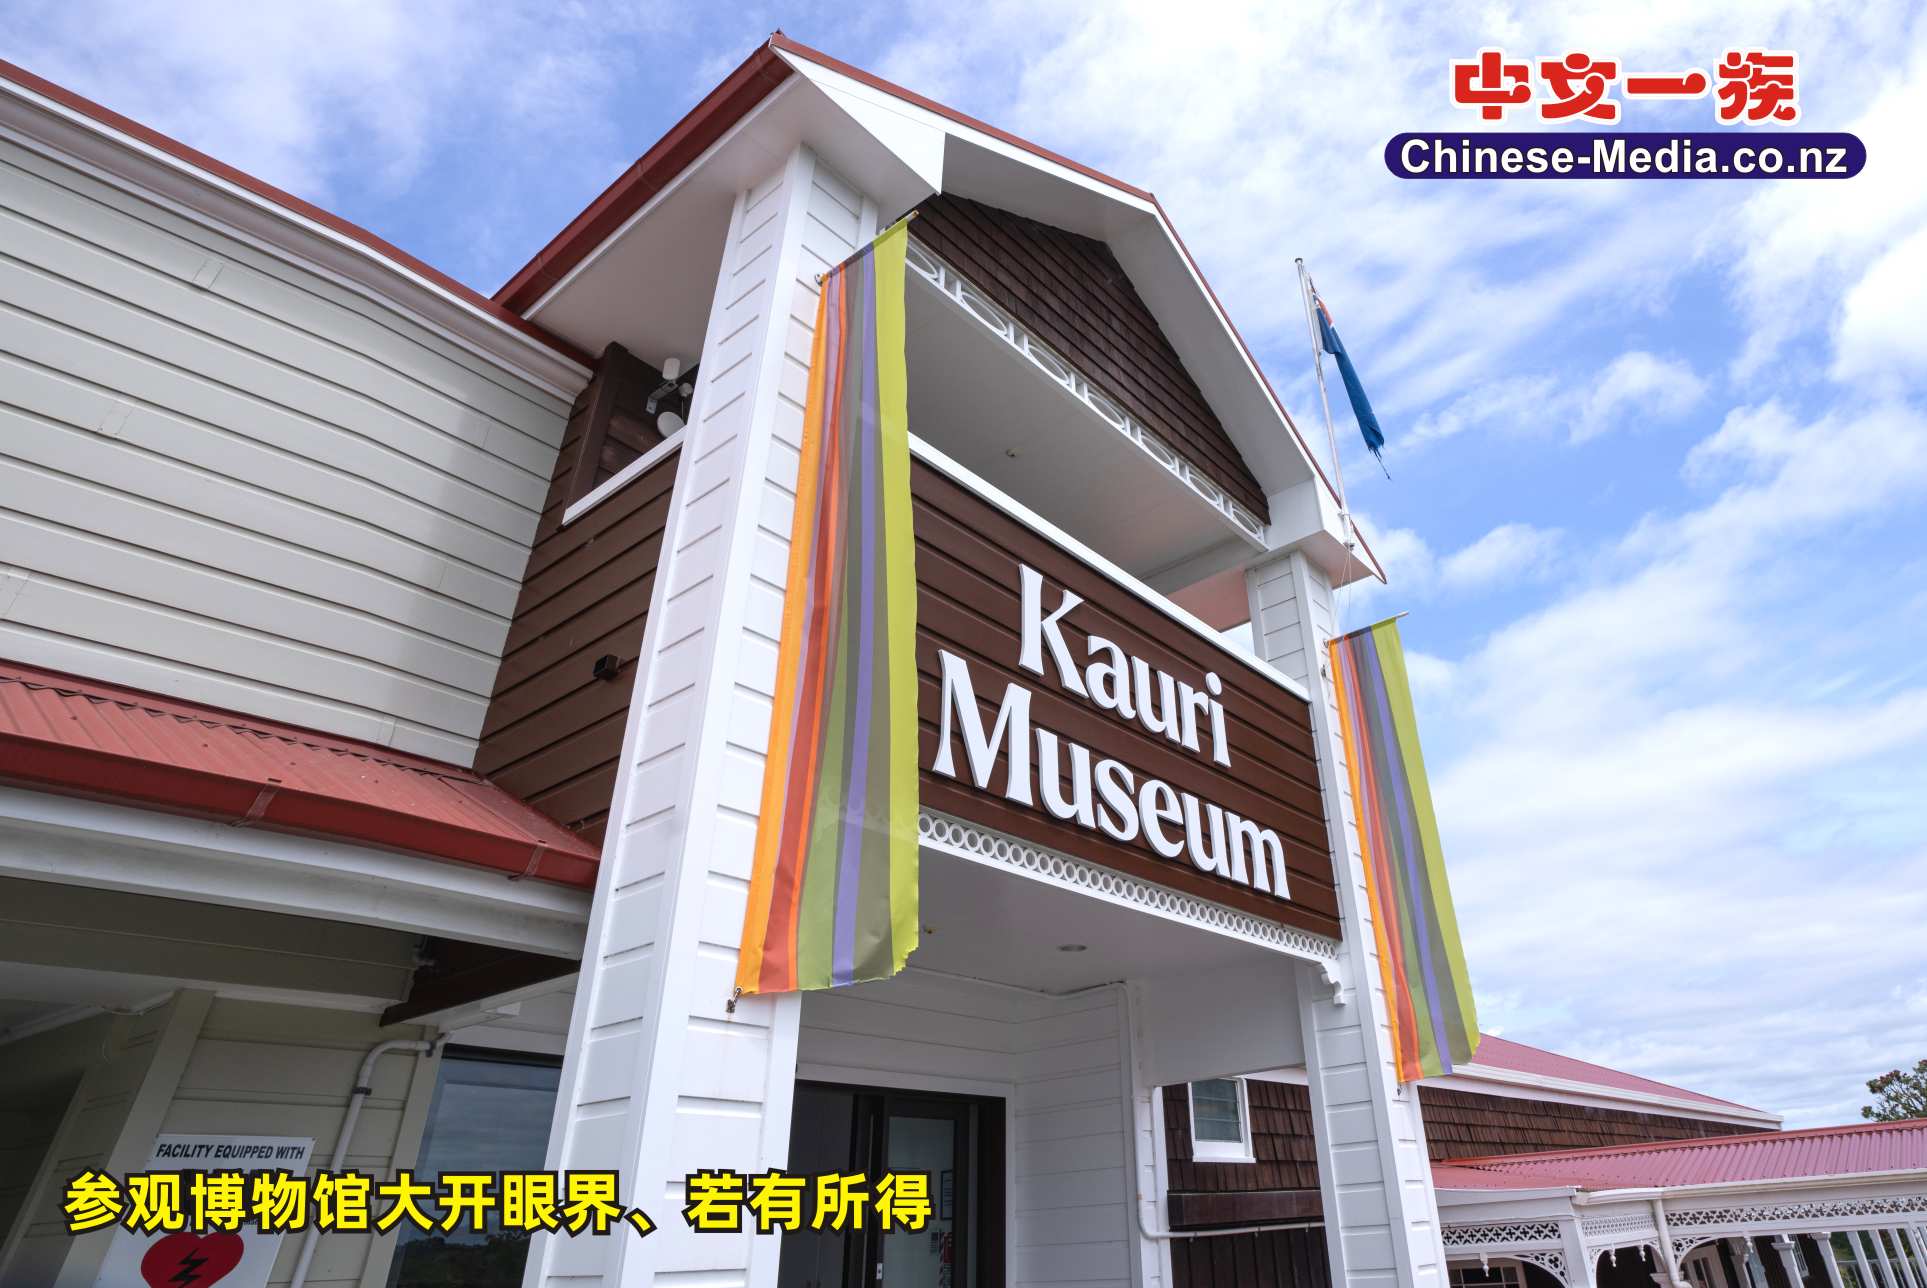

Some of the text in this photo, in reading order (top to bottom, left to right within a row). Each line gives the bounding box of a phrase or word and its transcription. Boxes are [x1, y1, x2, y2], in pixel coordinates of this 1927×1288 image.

[1018, 562, 1231, 768] Kauri
[932, 649, 1292, 900] Museum
[156, 1143, 305, 1160] FACILITY EQUIPPED WITH
